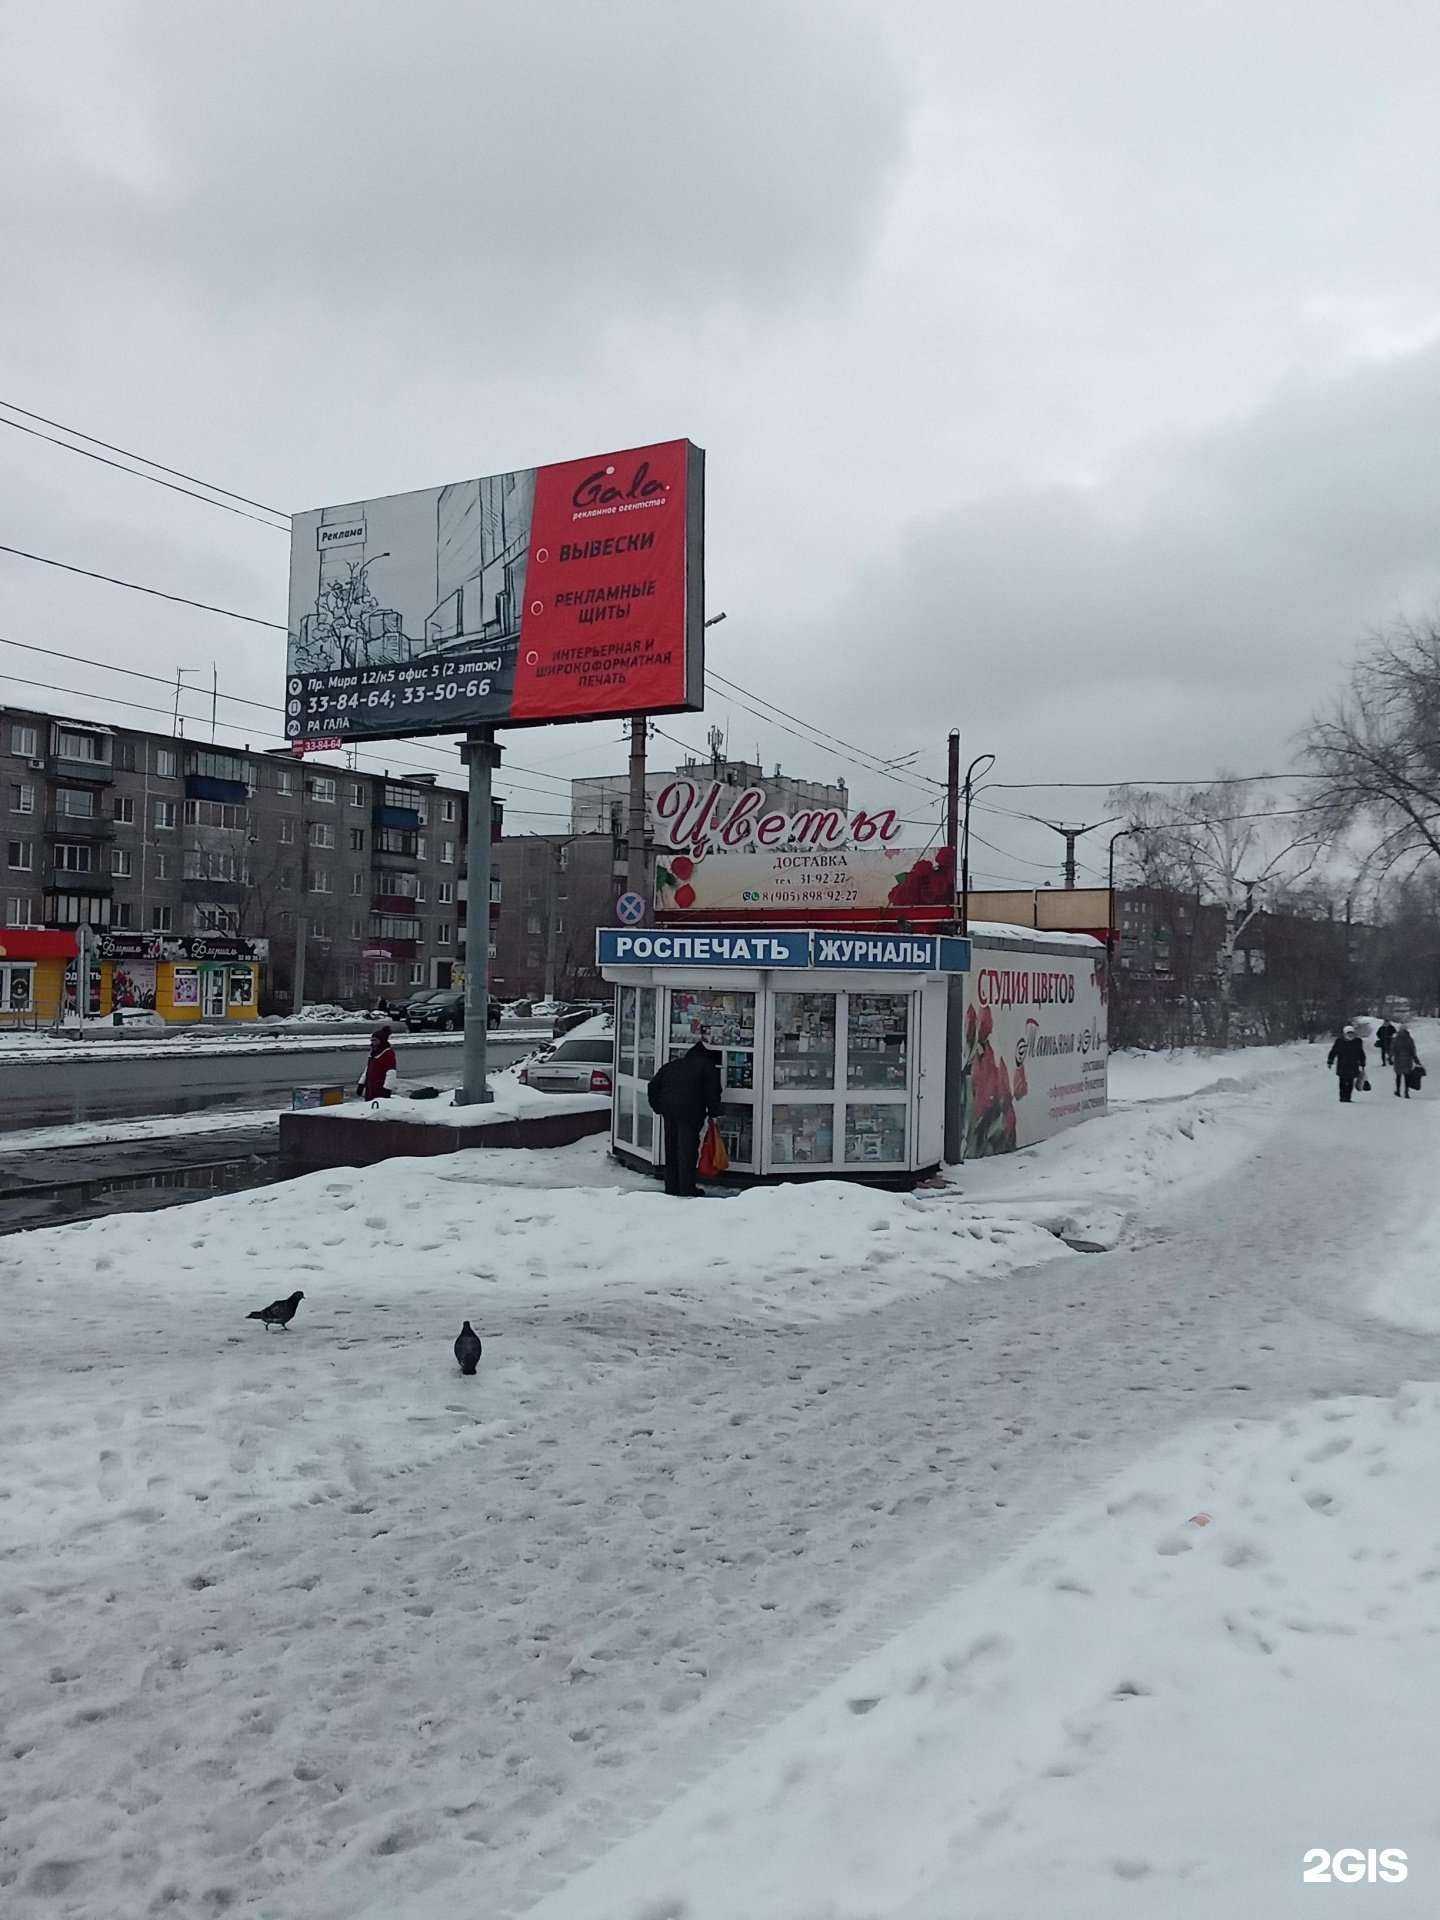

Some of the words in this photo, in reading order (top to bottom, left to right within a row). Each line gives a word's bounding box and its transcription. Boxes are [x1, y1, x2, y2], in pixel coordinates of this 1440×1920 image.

[572, 506, 617, 522] рекламное
[618, 497, 666, 512] агентство
[321, 527, 363, 542] Реклама
[559, 531, 656, 562] ВЫВЕСКИ
[554, 580, 657, 607] РЕКЛАМНЫЕ
[578, 603, 631, 625] ЩИТЫ
[551, 639, 641, 661] ИНТЕРЬЕРНАЯ
[644, 638, 655, 651] И
[307, 678, 326, 692] Пр.
[328, 675, 358, 690] Мира
[361, 669, 396, 685] 12/к5
[398, 666, 428, 684] офис
[430, 664, 440, 677] 5
[442, 662, 455, 678] (2
[457, 657, 502, 675] этаж)
[535, 651, 672, 678] ШИРОКОФОРМАТНАЯ
[578, 672, 626, 687] ПЕЧАТЬ
[306, 690, 396, 714] 33-84-64;
[401, 678, 492, 704] 33-50-66
[306, 718, 321, 732] РА
[323, 716, 350, 730] ГАЛА
[304, 739, 341, 751] 33-84-64
[656, 780, 901, 859] Цветы
[772, 855, 848, 870] ДОСТАВКА
[616, 937, 790, 960] РОСПЕЧАТЬ
[818, 939, 931, 964] ЖУРНАЛЫ
[977, 968, 1029, 1010] СТУДИЯ
[1031, 971, 1075, 1010] ЦВЕТОВ
